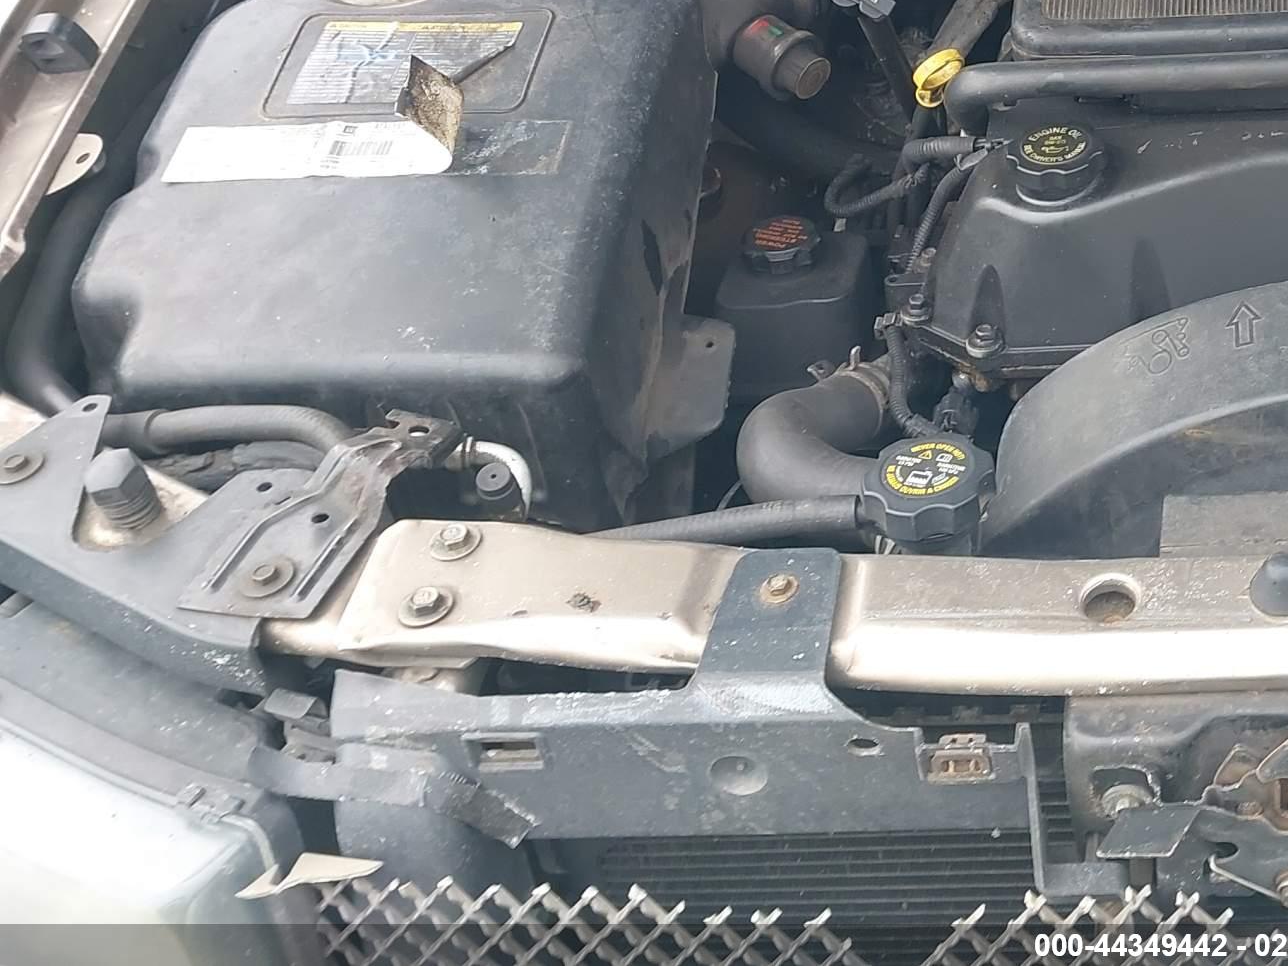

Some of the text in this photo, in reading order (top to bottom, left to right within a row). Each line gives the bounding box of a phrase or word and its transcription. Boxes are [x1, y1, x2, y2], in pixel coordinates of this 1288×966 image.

[1028, 127, 1083, 142] ENGINE OIL
[1023, 144, 1034, 155] SEE
[911, 443, 936, 453] NEVER
[936, 443, 956, 453] OPEN
